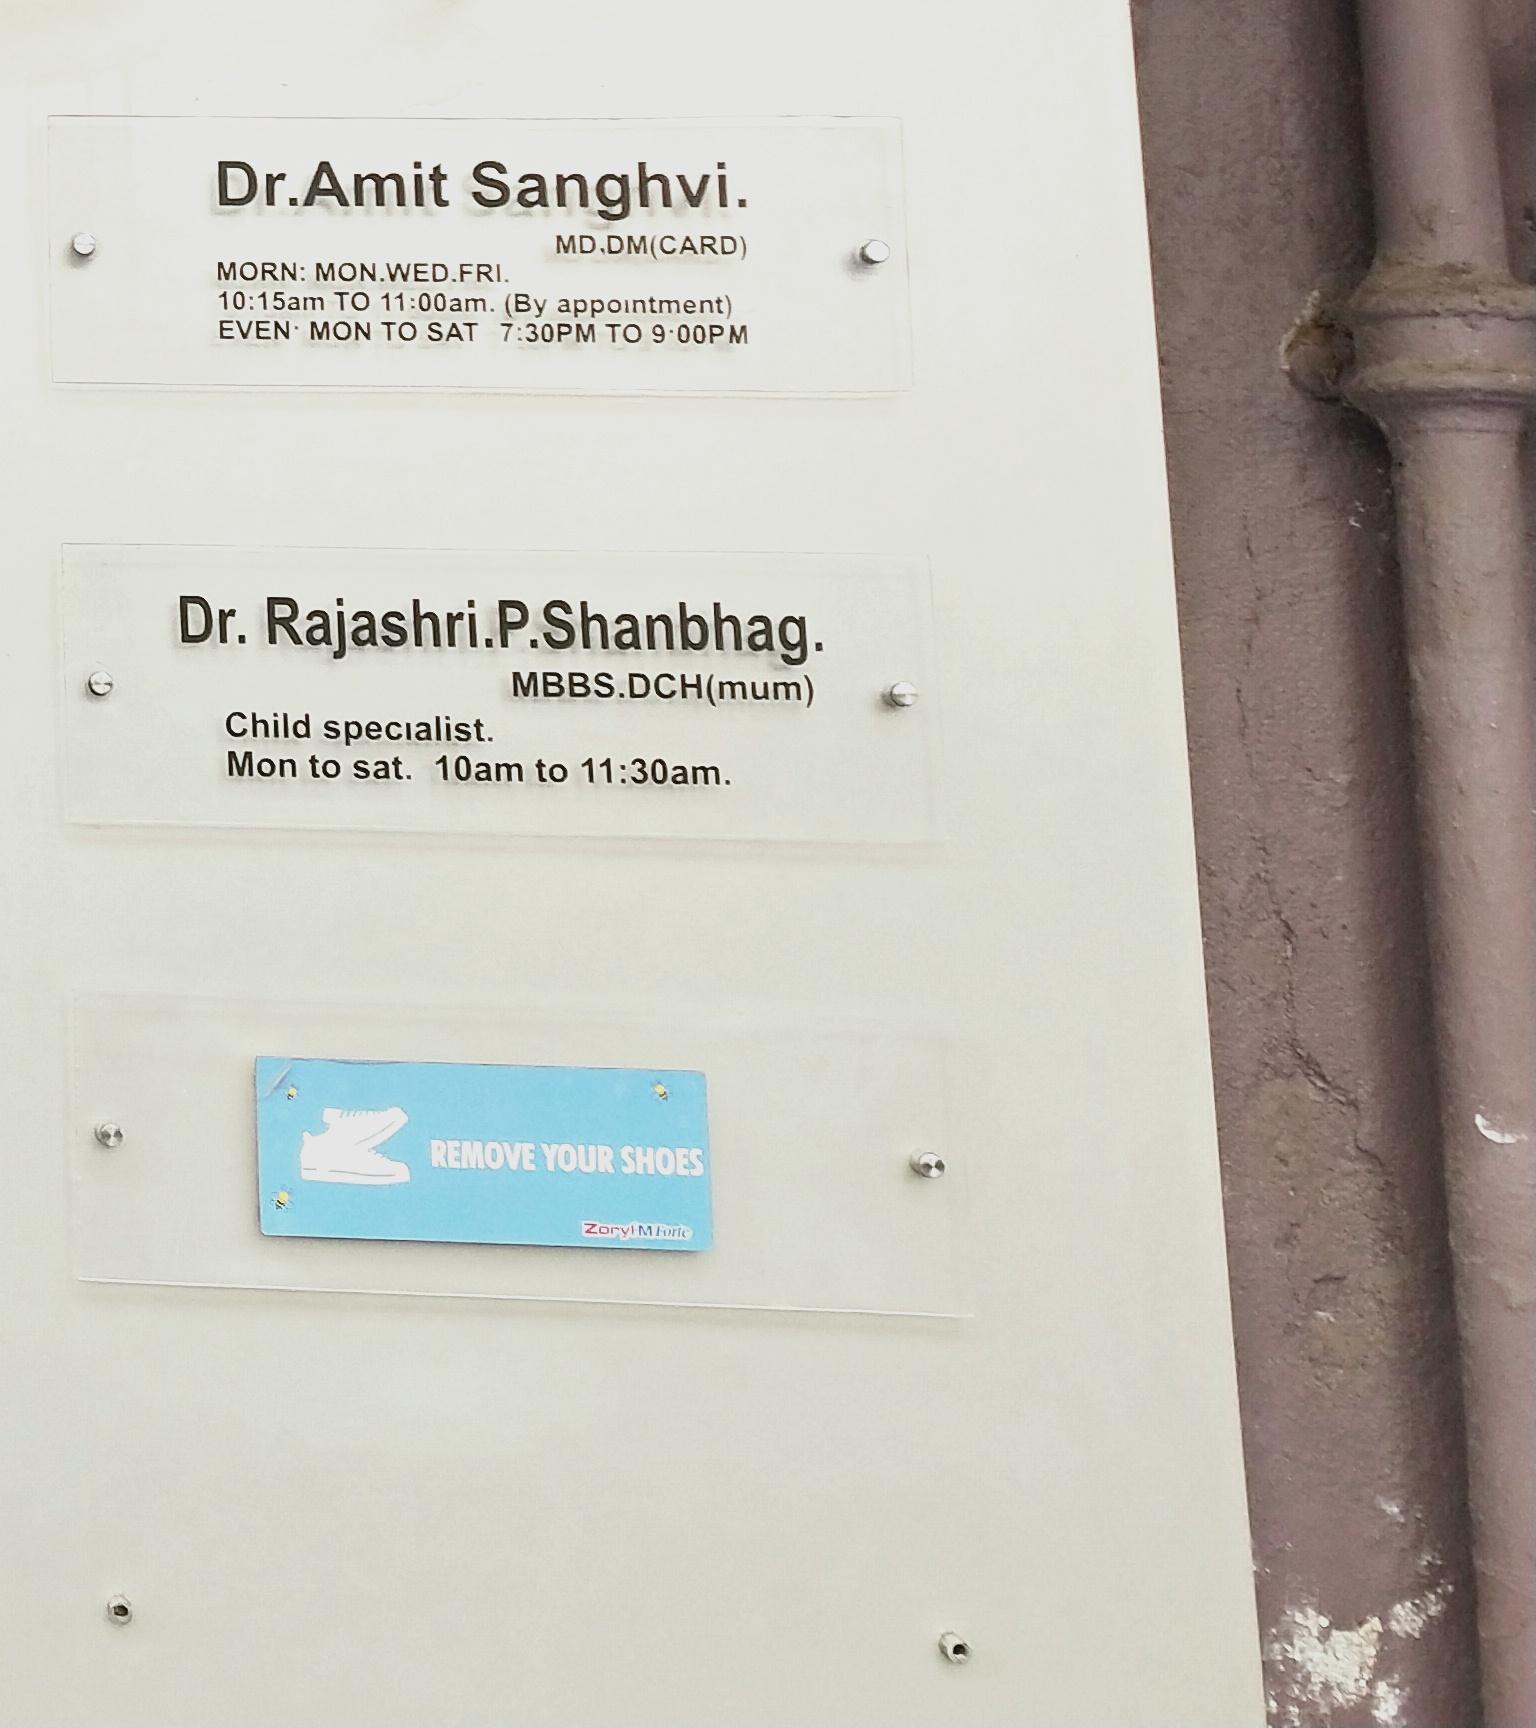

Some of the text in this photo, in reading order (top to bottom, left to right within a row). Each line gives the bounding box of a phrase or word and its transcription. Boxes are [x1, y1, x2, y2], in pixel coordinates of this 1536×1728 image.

[216, 160, 748, 221] Dr.Amit Sanghvi.
[216, 261, 510, 284] MORN: MON.WED.FRI.
[217, 290, 733, 320] 10:15am TO 11:00am. (By appointment)
[309, 320, 371, 341] MON
[380, 321, 418, 342] TO
[426, 321, 479, 342] SAT
[500, 322, 596, 344] 7:30PM
[605, 322, 642, 344] TO
[178, 595, 247, 645] Dr.
[511, 671, 816, 709] MBBS.DCH(mum)
[225, 712, 495, 747] Child specialist.
[227, 751, 732, 786] Mon to sat. 10am to 11:30am.
[430, 1138, 704, 1177] REMOVE YOUR SHOES
